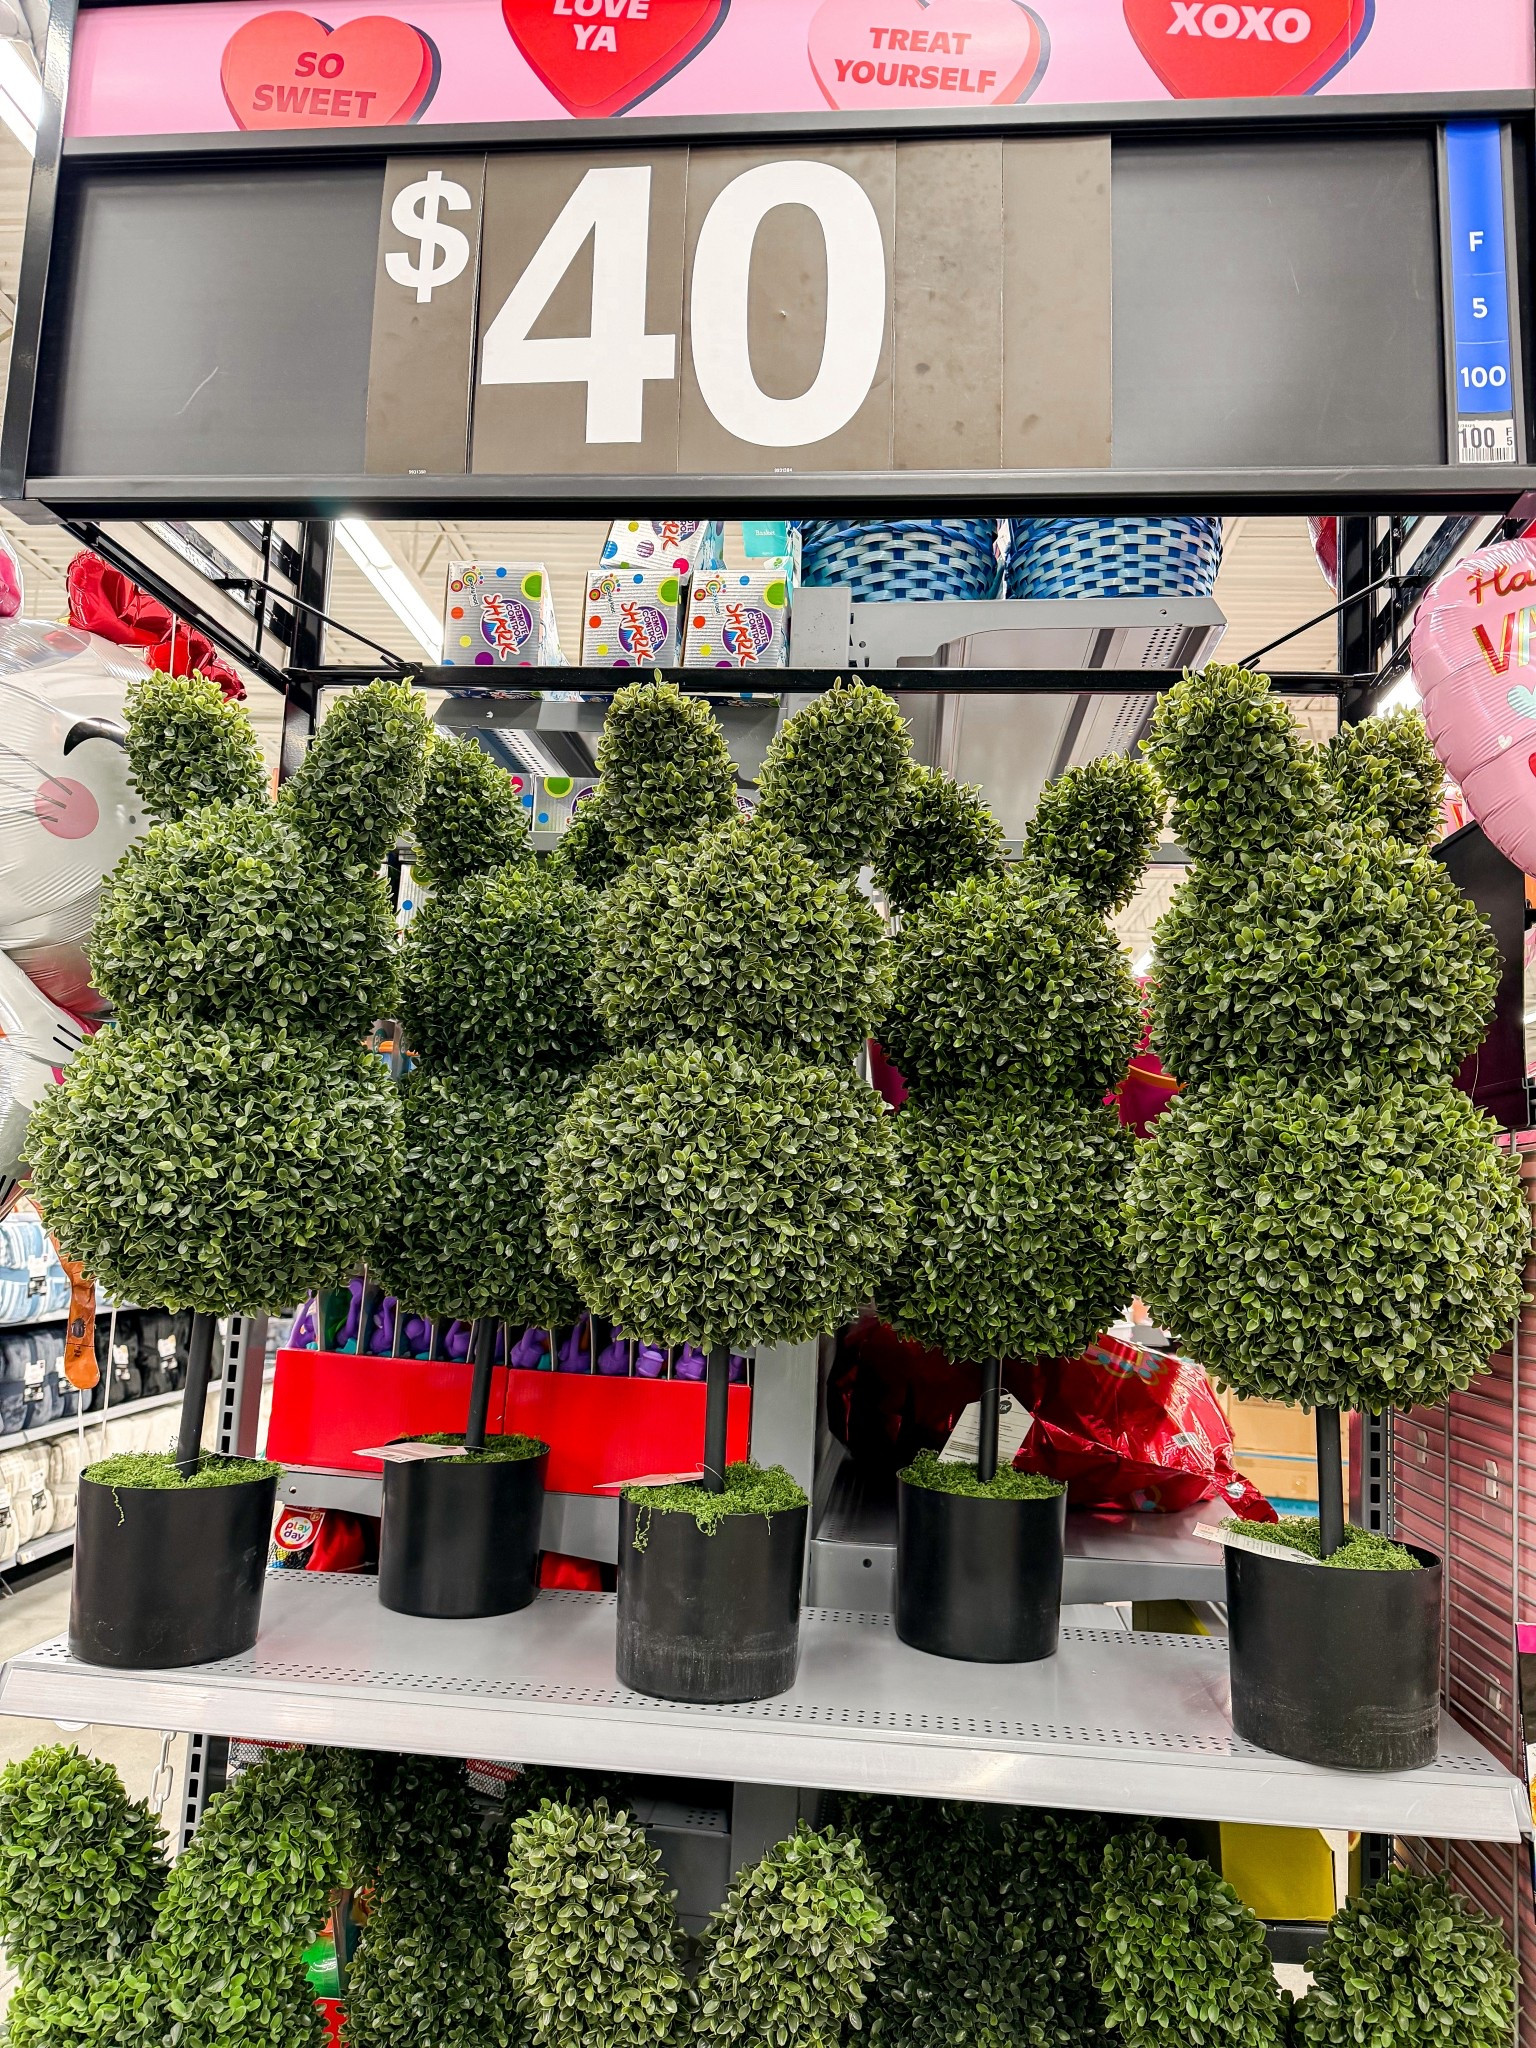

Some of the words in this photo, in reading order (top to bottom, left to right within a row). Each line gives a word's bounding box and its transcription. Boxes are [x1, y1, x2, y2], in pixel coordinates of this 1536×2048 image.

[553, 0, 650, 19] LOVE
[1166, 1, 1311, 44] XOXO
[573, 24, 617, 52] YA
[870, 27, 971, 55] TREAT
[295, 52, 344, 78] SO
[834, 59, 996, 93] YOURSELF
[253, 84, 376, 118] SWEET
[1469, 231, 1484, 252] F
[1472, 298, 1488, 318] 5
[1460, 366, 1506, 388] 100
[1458, 427, 1495, 448] 100
[483, 594, 519, 660] SHARK
[506, 604, 522, 641] CONTROL
[514, 604, 529, 635] REMOTE
[620, 601, 655, 665] SHARK
[642, 610, 658, 647] CONTROL
[650, 610, 665, 641] REMOTE
[724, 603, 759, 667] SHARK
[747, 612, 762, 650] CONTROL
[755, 612, 769, 644] REMOTE
[283, 1530, 305, 1541] day
[284, 1521, 311, 1533] play
